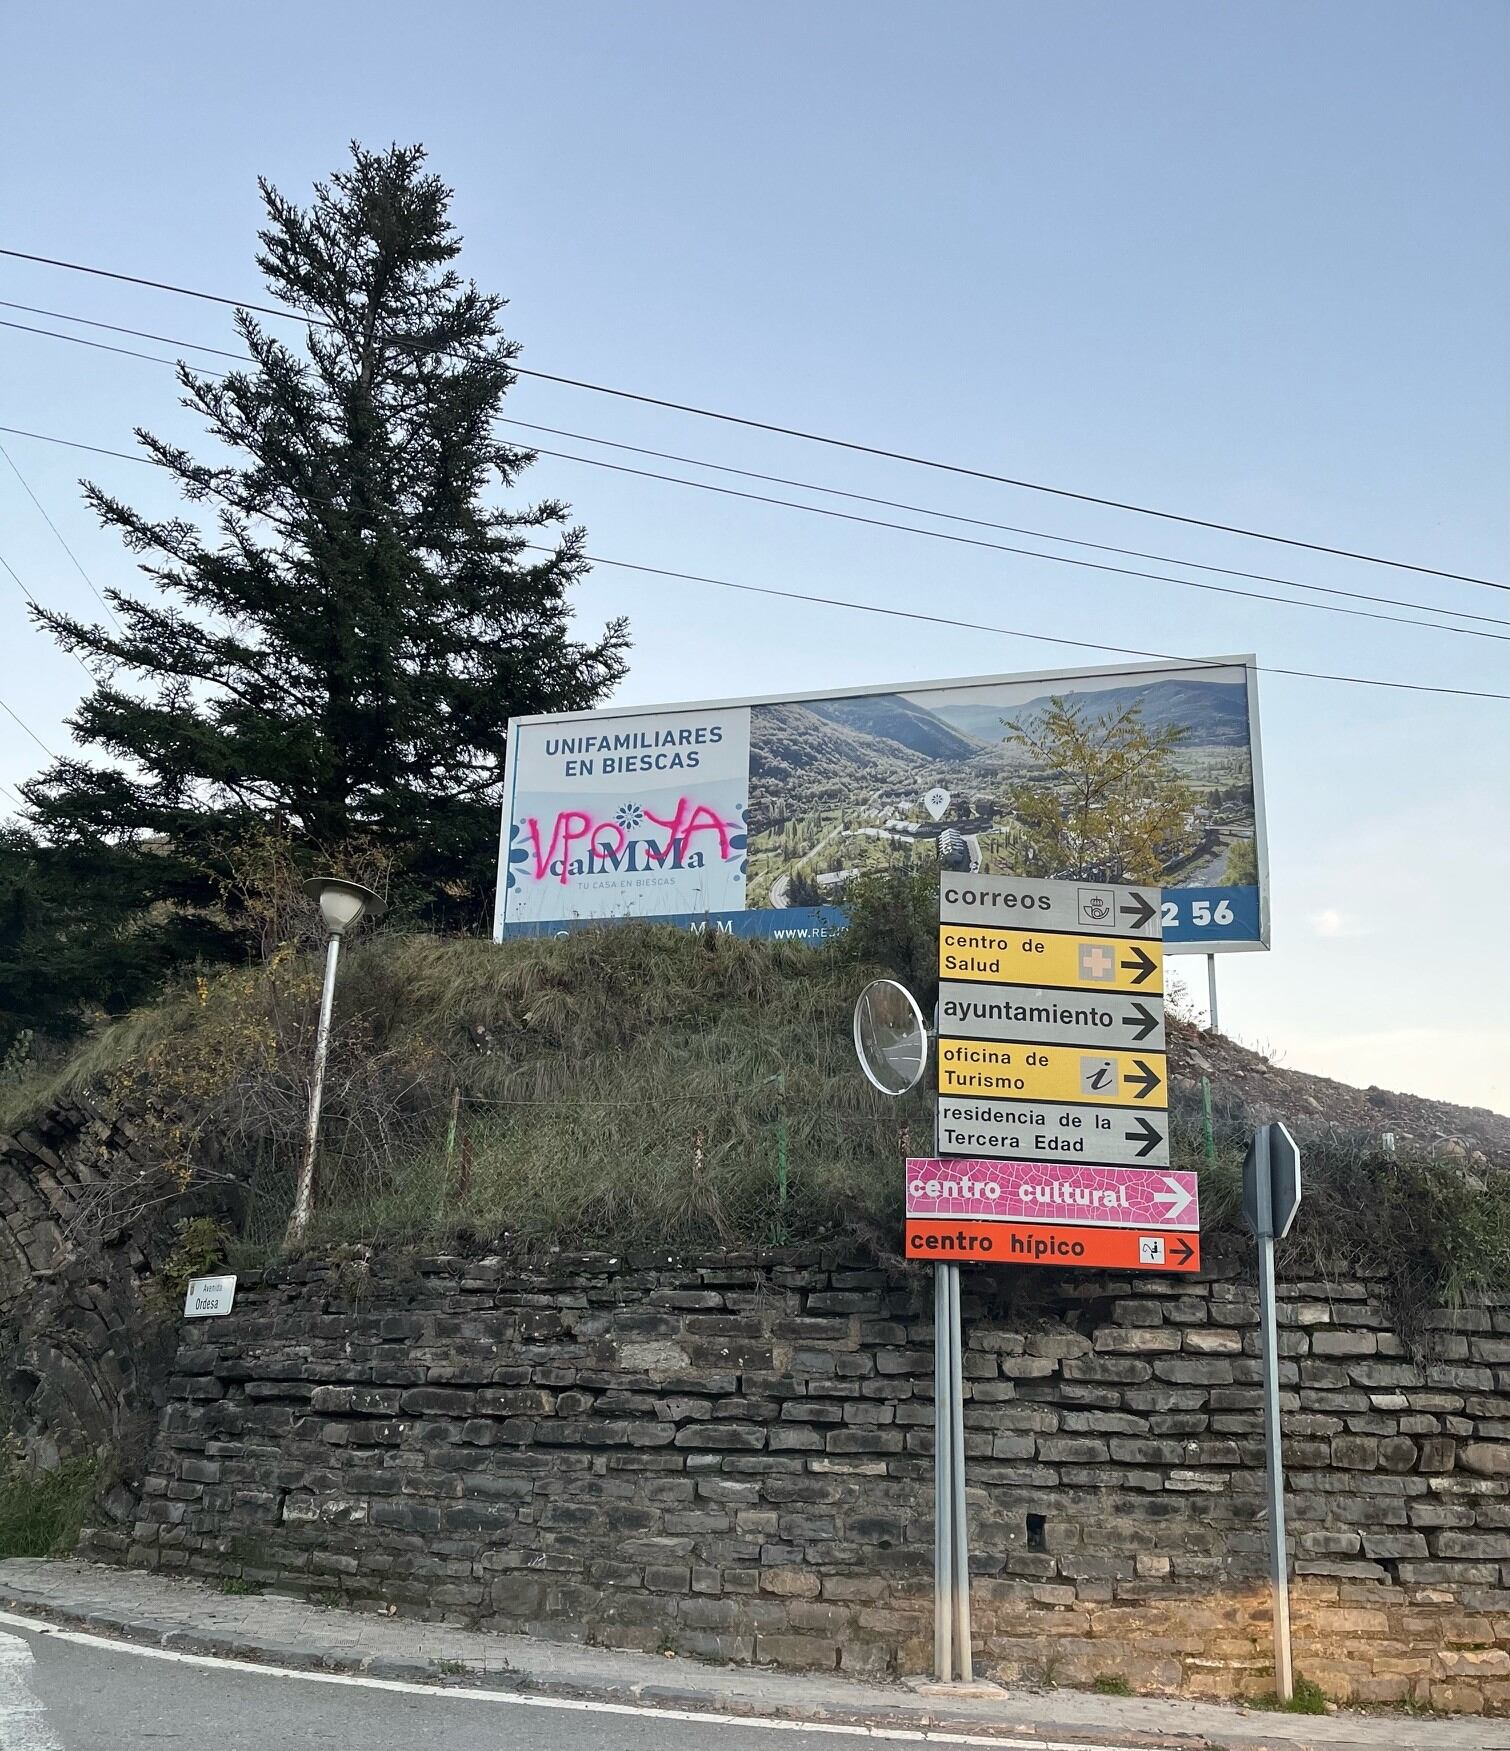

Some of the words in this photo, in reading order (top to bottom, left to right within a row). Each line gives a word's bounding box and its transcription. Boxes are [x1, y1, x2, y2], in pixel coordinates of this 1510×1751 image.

[545, 726, 723, 756] UNIFAMILIARES
[565, 759, 594, 777] EN
[602, 751, 701, 775] BIESCAS
[577, 882, 590, 890] TU
[592, 880, 617, 889] CASA
[620, 879, 633, 887] EN
[635, 877, 677, 886] BIESCAS
[944, 888, 1052, 911] correos
[1192, 900, 1234, 926] 56
[944, 935, 1008, 951] centro
[1021, 938, 1045, 953] de
[945, 956, 1000, 973] Salud
[944, 1001, 1113, 1028] ayuntamiento
[944, 1048, 1011, 1065] oficina
[1025, 1051, 1049, 1067] de
[945, 1070, 1025, 1090] Turismo
[943, 1106, 1046, 1126] residencia
[1059, 1112, 1082, 1128] de
[1095, 1115, 1111, 1130] la
[945, 1130, 1020, 1148] Tercera
[1034, 1134, 1084, 1152] Edad
[909, 1177, 1001, 1200] centro
[1019, 1182, 1129, 1208] cultural
[910, 1231, 993, 1252] centro
[1011, 1234, 1085, 1259] hípico
[195, 1298, 219, 1310] Ordesa
